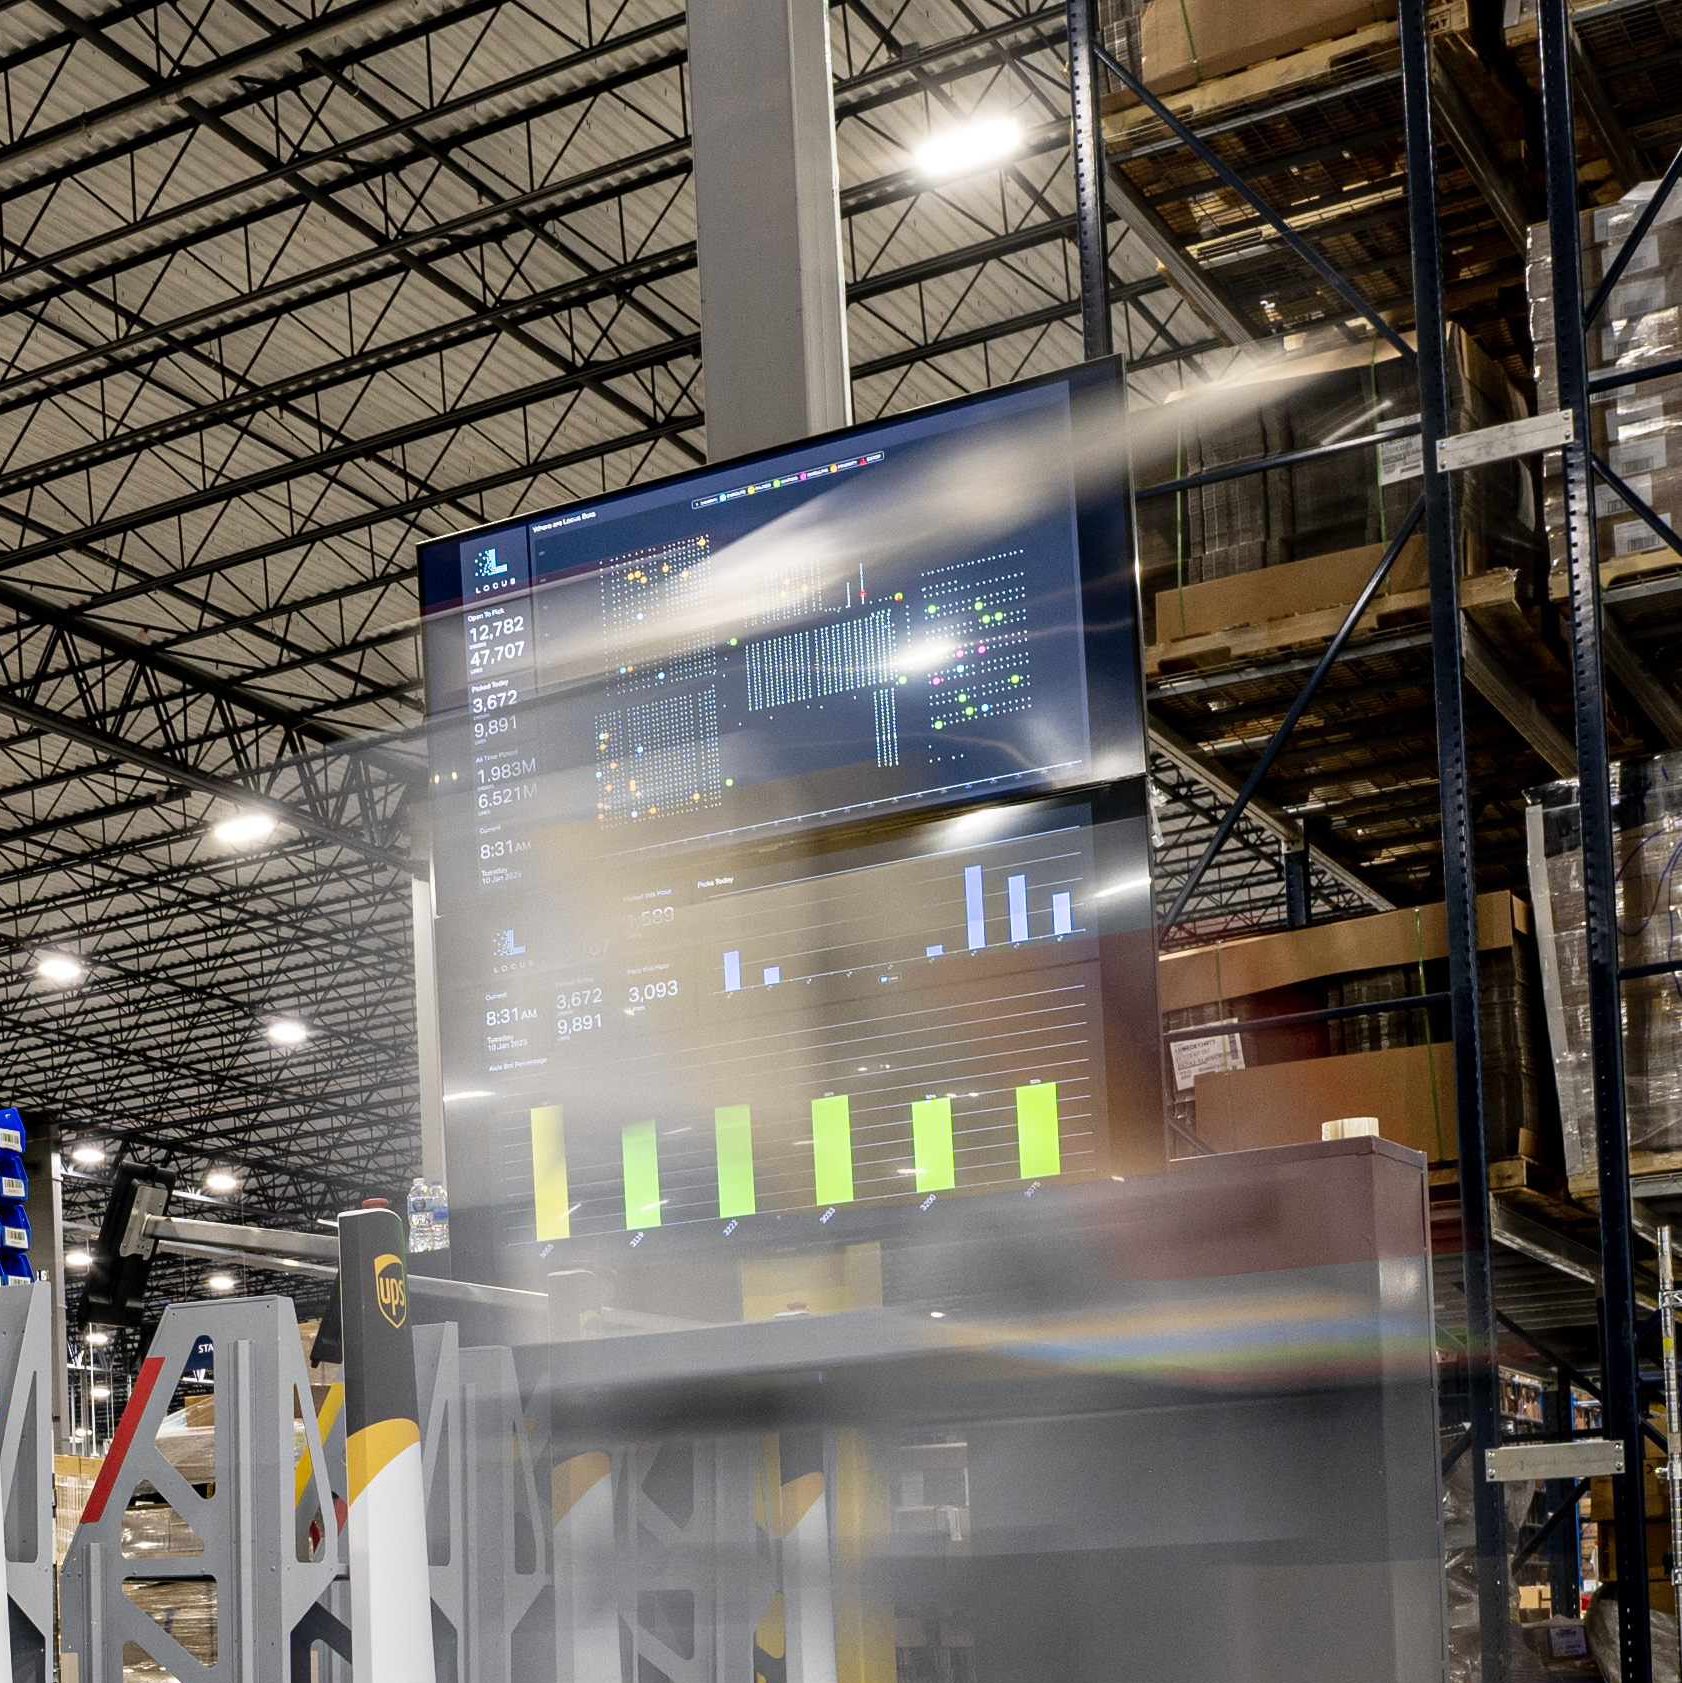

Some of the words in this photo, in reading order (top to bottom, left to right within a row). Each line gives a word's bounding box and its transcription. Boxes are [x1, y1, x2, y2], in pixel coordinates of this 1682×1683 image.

[553, 520, 563, 528] are
[563, 515, 581, 526] Locus
[475, 577, 516, 594] LOCUS
[467, 613, 484, 623] Open
[492, 607, 505, 616] Pick
[469, 615, 524, 642] 12,782
[470, 641, 525, 666] 47,707
[471, 682, 492, 693] Picked
[492, 679, 509, 688] Today
[472, 689, 518, 713] 3,672
[474, 715, 517, 738] 9,891
[475, 756, 483, 764] All
[477, 757, 536, 784] 1.983M
[478, 783, 537, 809] 6.521M
[481, 867, 508, 878] Tuesday
[482, 876, 491, 885] 10
[491, 874, 504, 884] Jan
[715, 876, 734, 886] Today
[656, 888, 672, 897] Hour
[485, 991, 507, 1001] Current
[556, 987, 603, 1010] 3,672
[628, 979, 679, 1003] 3,093
[557, 1013, 603, 1035] 9,891
[487, 1033, 514, 1045] Tuesday
[487, 1043, 496, 1052] 10
[497, 1041, 510, 1051] Jan
[511, 1039, 528, 1049] 2023
[1023, 1180, 1041, 1198] 3075
[919, 1193, 936, 1211] 3200
[722, 1219, 739, 1236] 3222
[379, 1277, 405, 1316] ups
